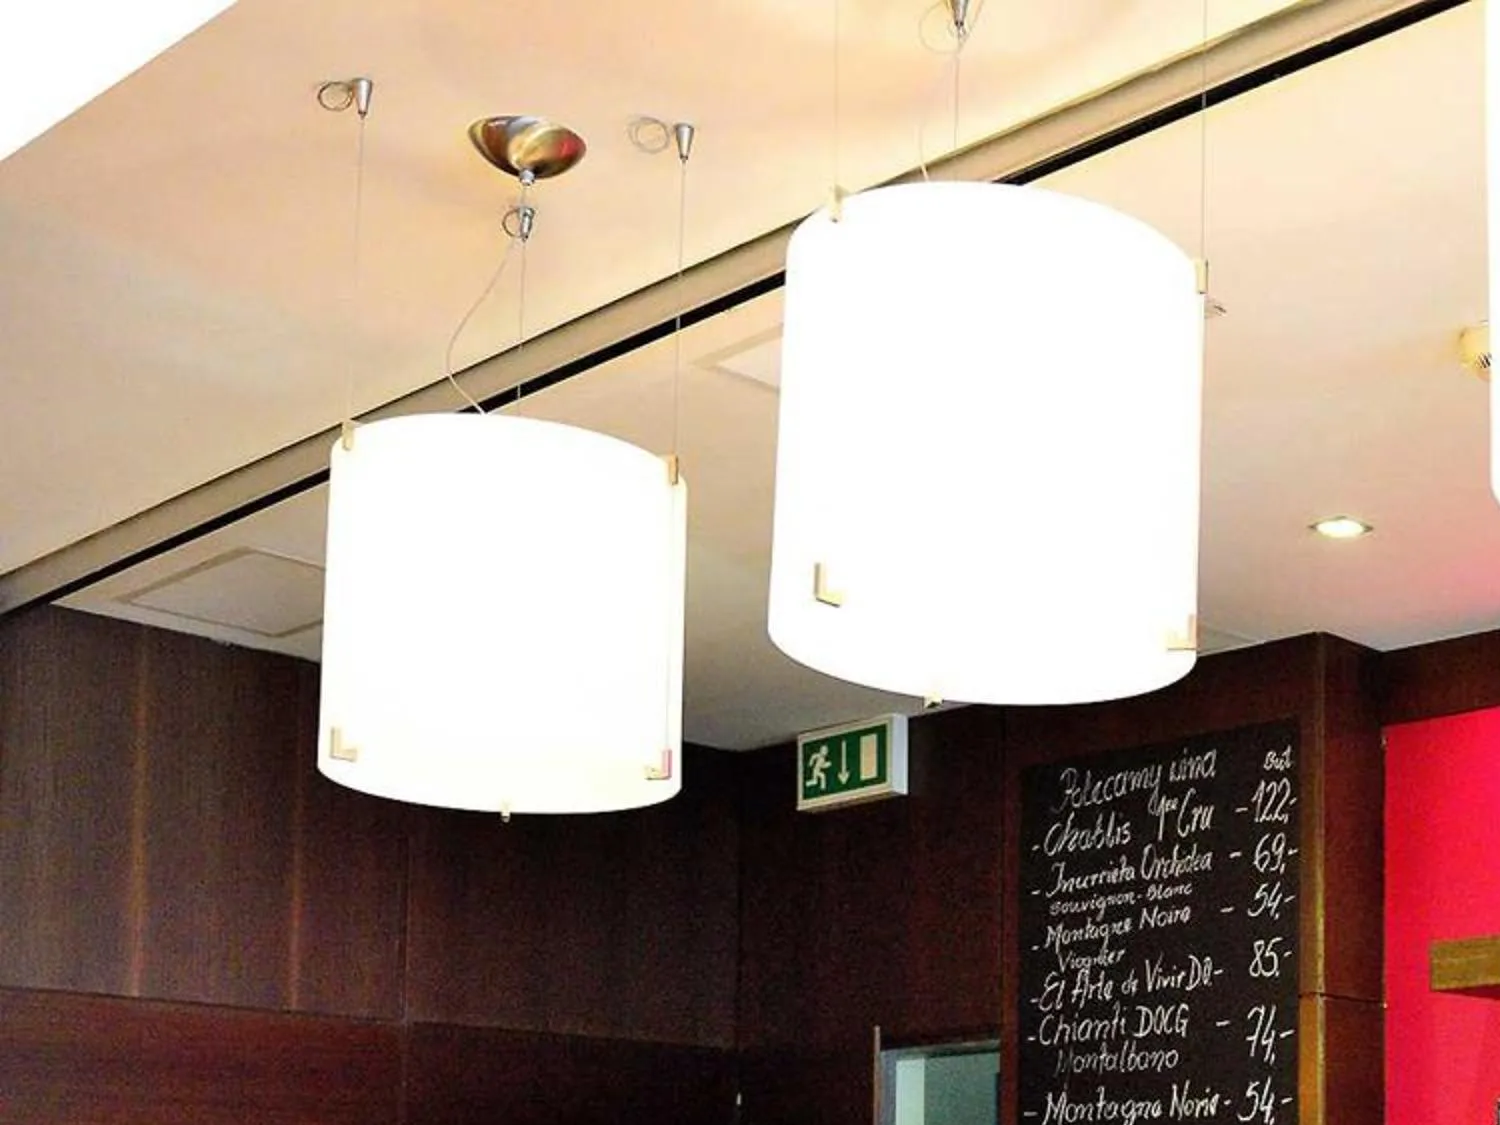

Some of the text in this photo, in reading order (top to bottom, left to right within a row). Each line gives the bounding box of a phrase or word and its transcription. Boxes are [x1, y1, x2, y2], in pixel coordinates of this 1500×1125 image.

[1043, 811, 1132, 857] Chablis
[1177, 787, 1215, 838] Cru
[1039, 1002, 1126, 1046] Chianti
[1133, 1003, 1189, 1038] DOCG
